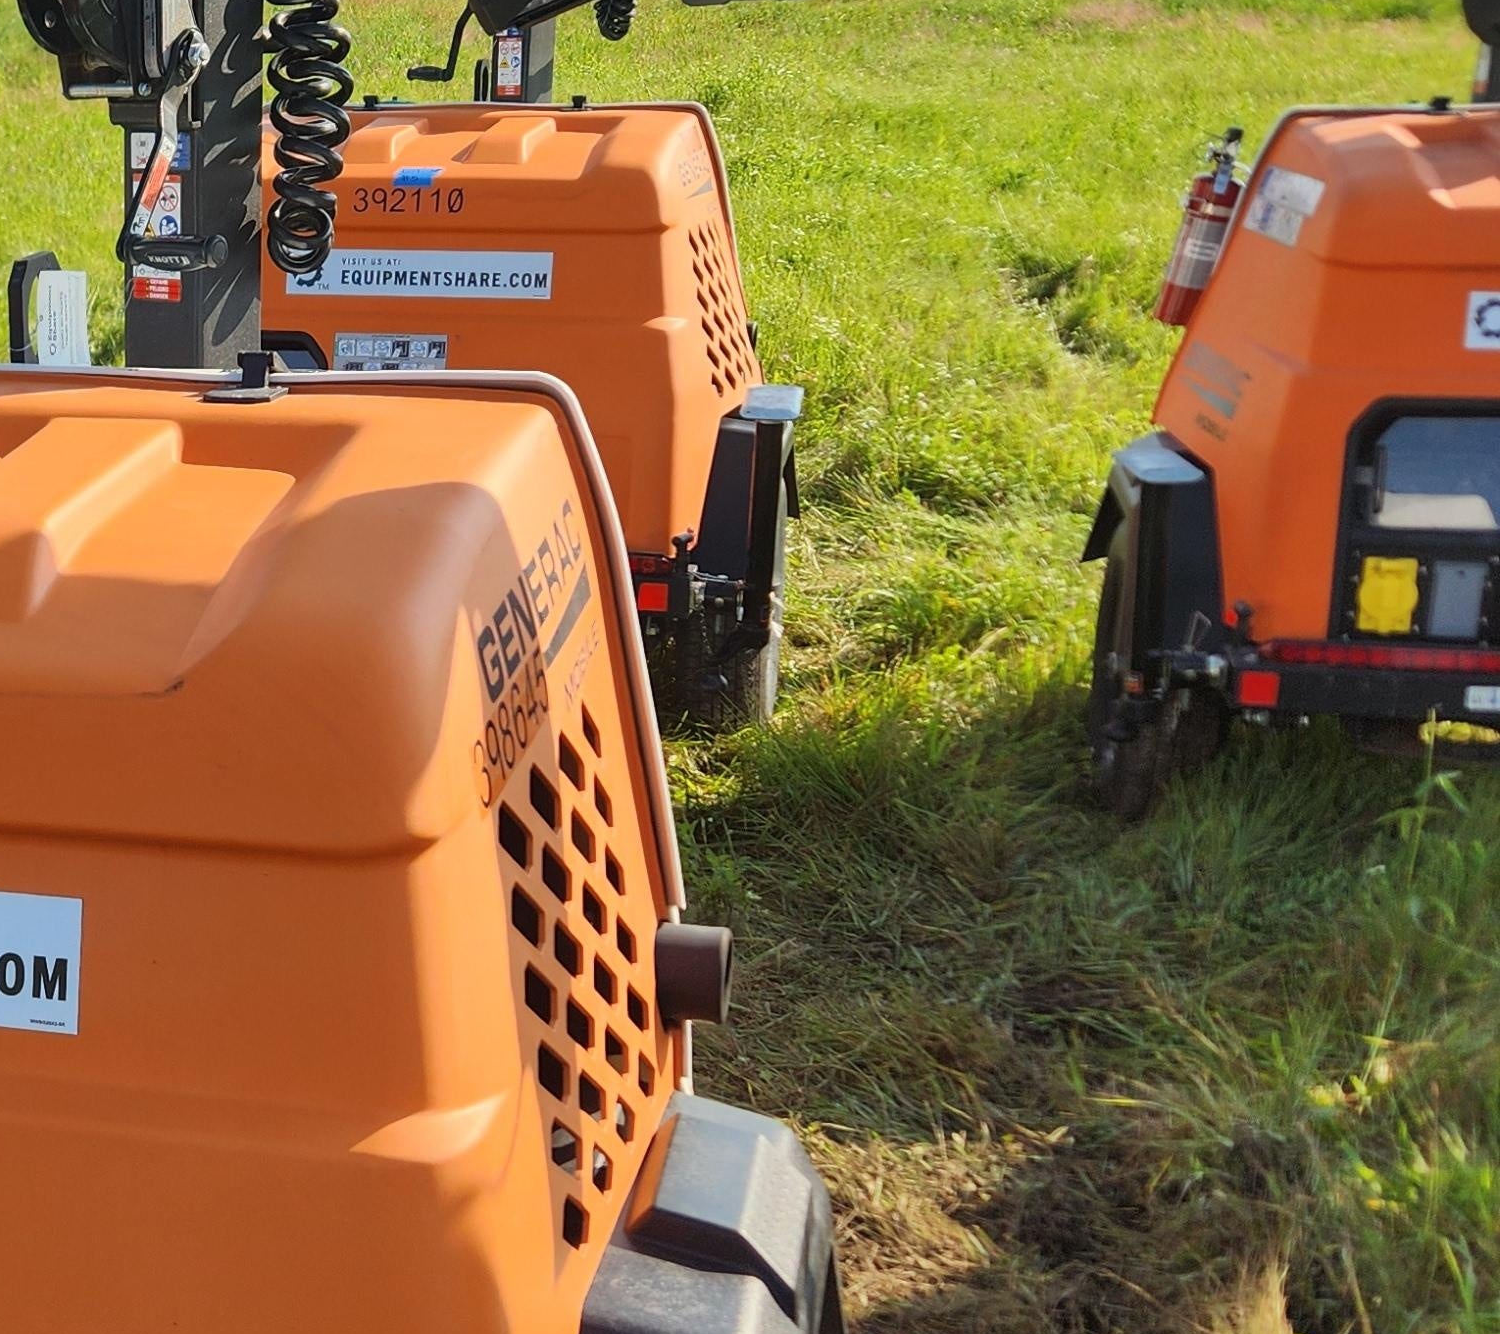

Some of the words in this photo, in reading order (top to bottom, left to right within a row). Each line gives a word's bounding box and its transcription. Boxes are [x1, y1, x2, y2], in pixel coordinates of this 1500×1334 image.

[147, 255, 180, 264] KNOTT
[341, 257, 366, 266] VISIT
[370, 258, 383, 266] US
[340, 269, 548, 289] EQUIPMENTSHARE.COM
[478, 499, 582, 703] GENERAC
[474, 648, 549, 809] 398645
